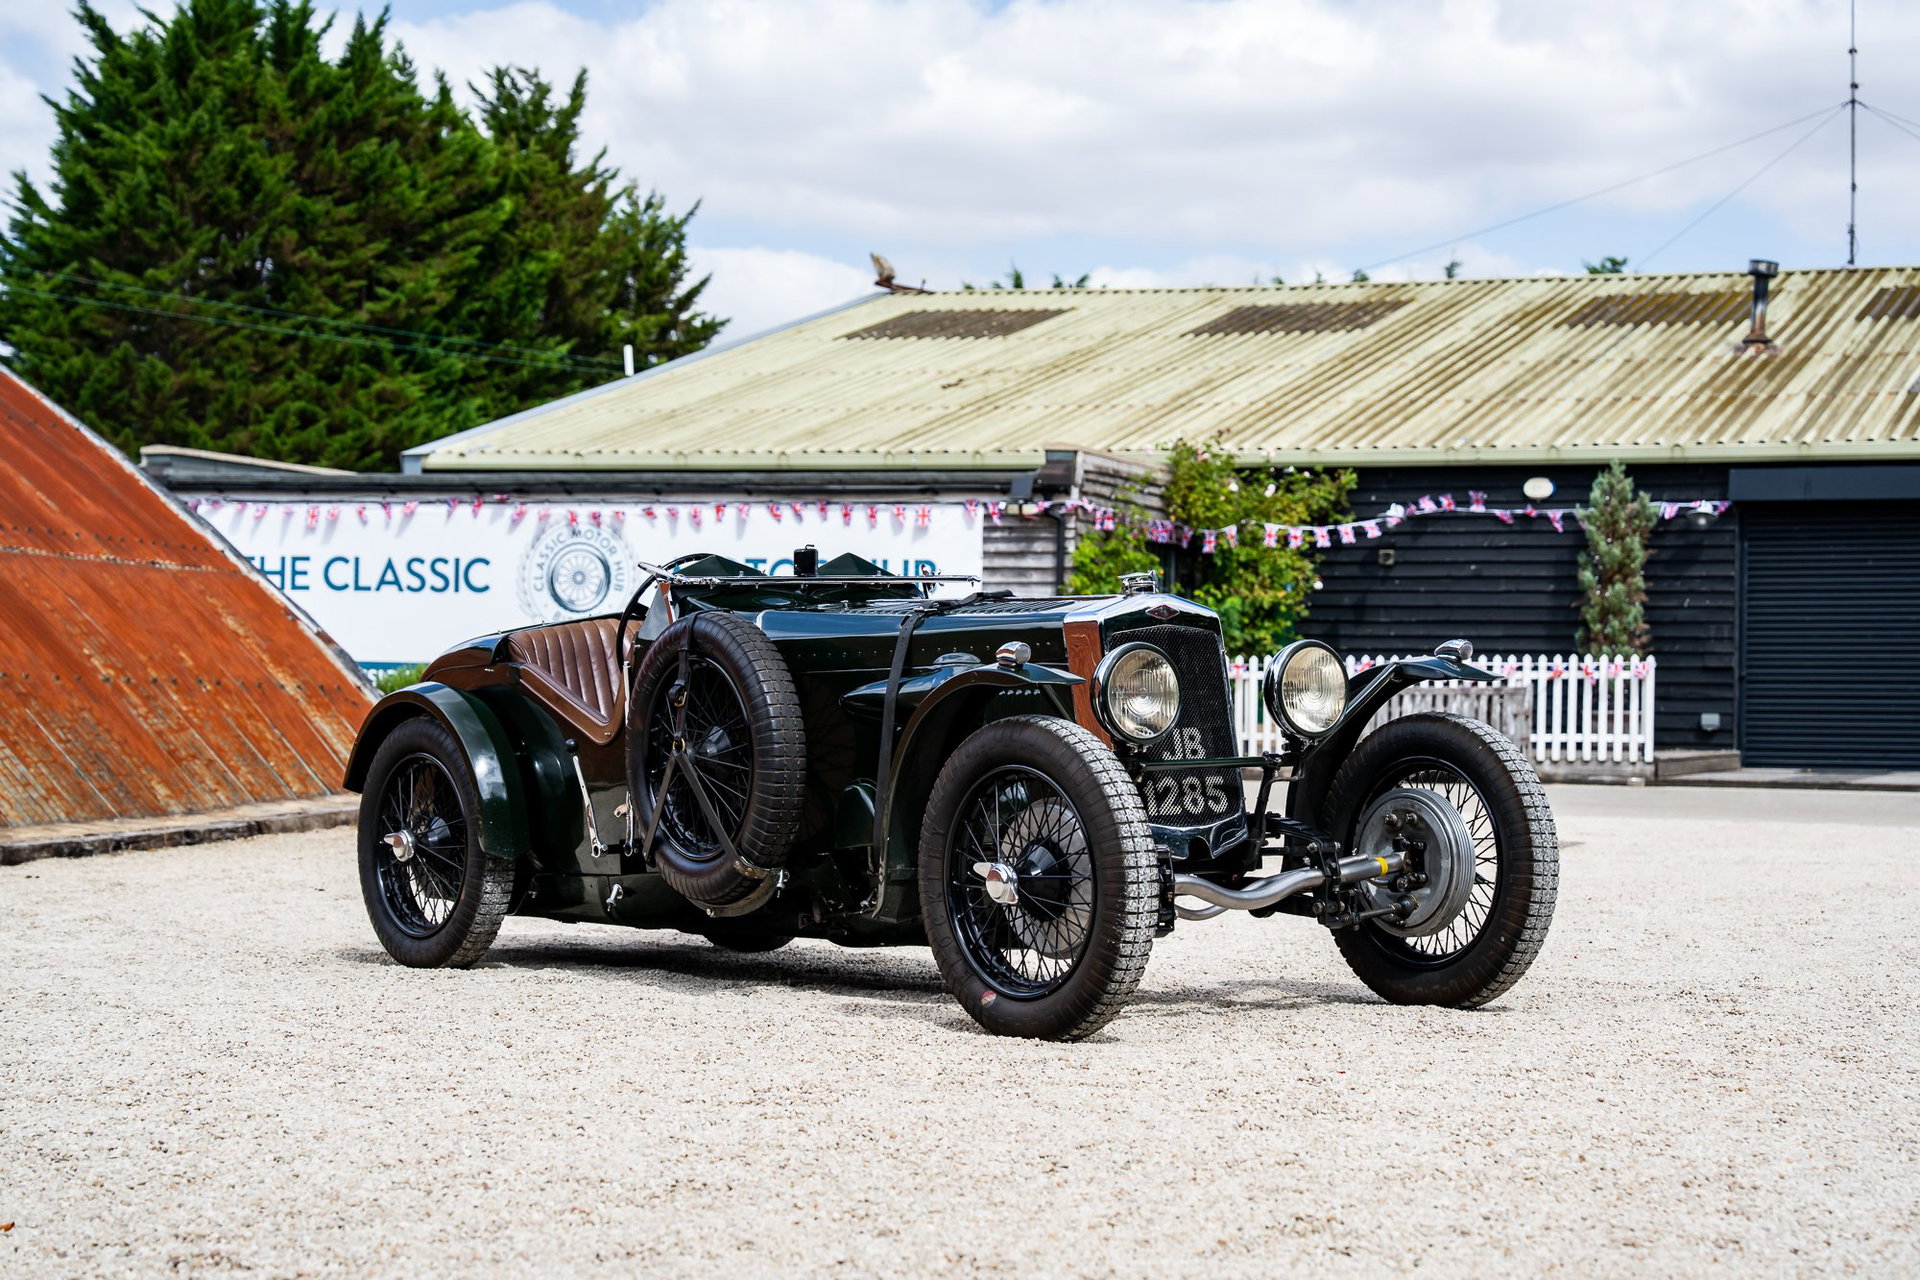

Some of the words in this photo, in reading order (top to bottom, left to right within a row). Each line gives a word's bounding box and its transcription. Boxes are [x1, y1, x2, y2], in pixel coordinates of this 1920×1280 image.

[246, 556, 310, 594] HE
[323, 556, 490, 592] CLASSIC
[533, 532, 567, 592] CLASSIC
[1143, 776, 1229, 817] 1285
